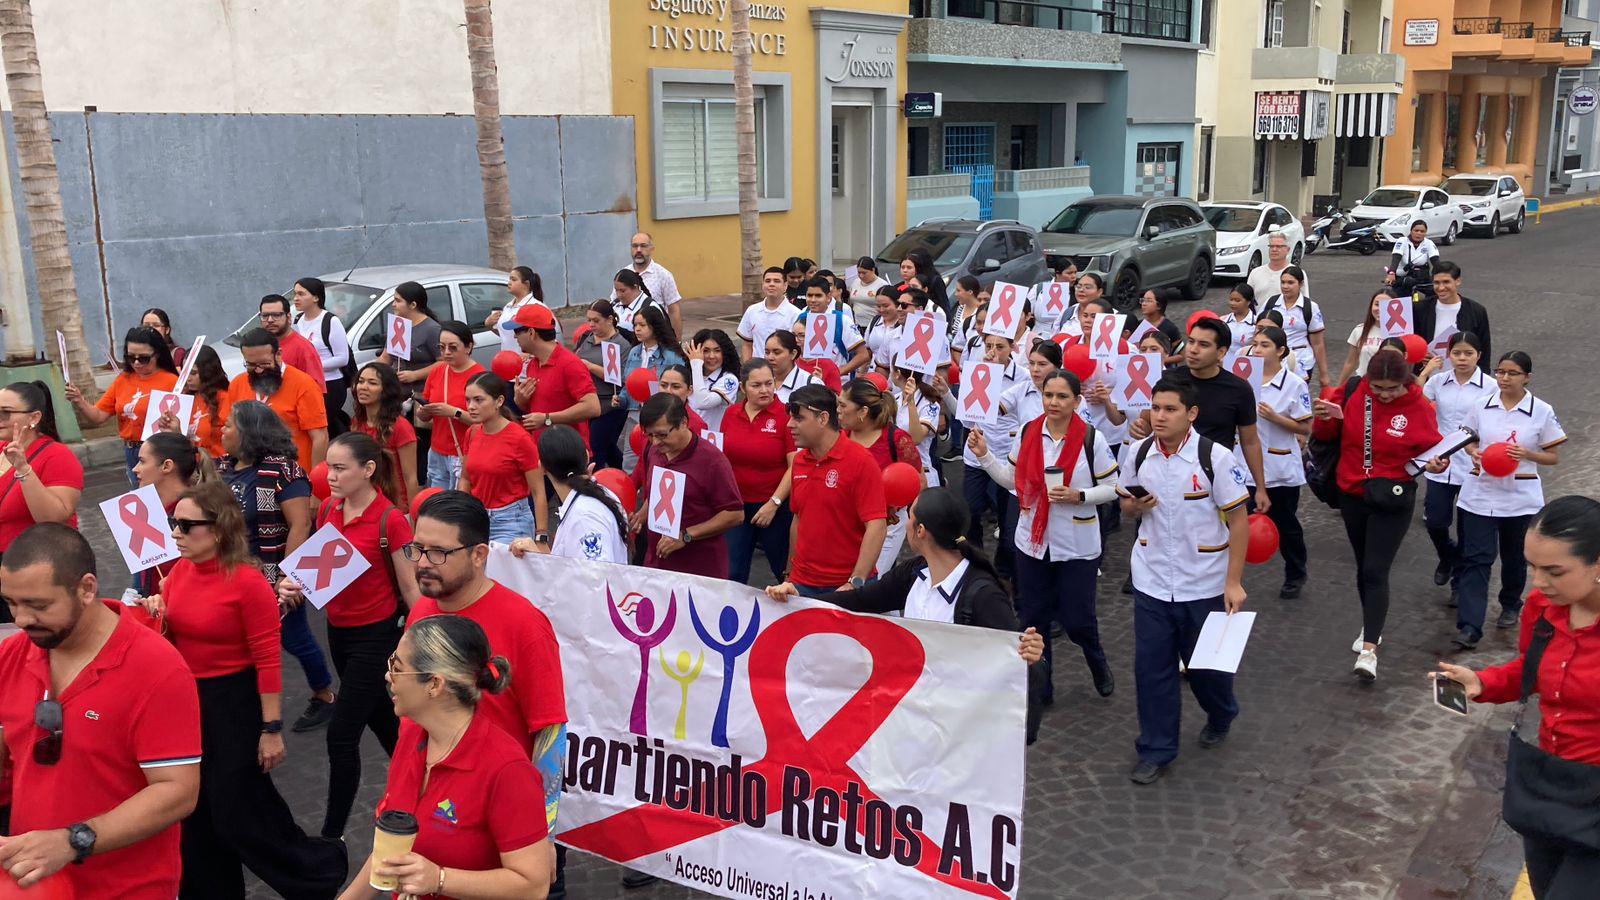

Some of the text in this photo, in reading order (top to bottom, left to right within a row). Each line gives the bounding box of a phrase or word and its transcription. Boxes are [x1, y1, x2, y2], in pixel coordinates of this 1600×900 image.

[718, 0, 727, 21] y
[748, 3, 787, 20] anzas
[649, 25, 786, 55] INSURNCE
[825, 33, 894, 83] JONSSON
[1259, 105, 1299, 114] FOR RENT
[1260, 95, 1299, 105] SE RENTA
[1258, 115, 1298, 133] 669 116 3719
[781, 764, 923, 867] Retos
[938, 801, 1017, 893] A.C
[675, 855, 723, 888] Acceso
[727, 867, 789, 900] Universal
